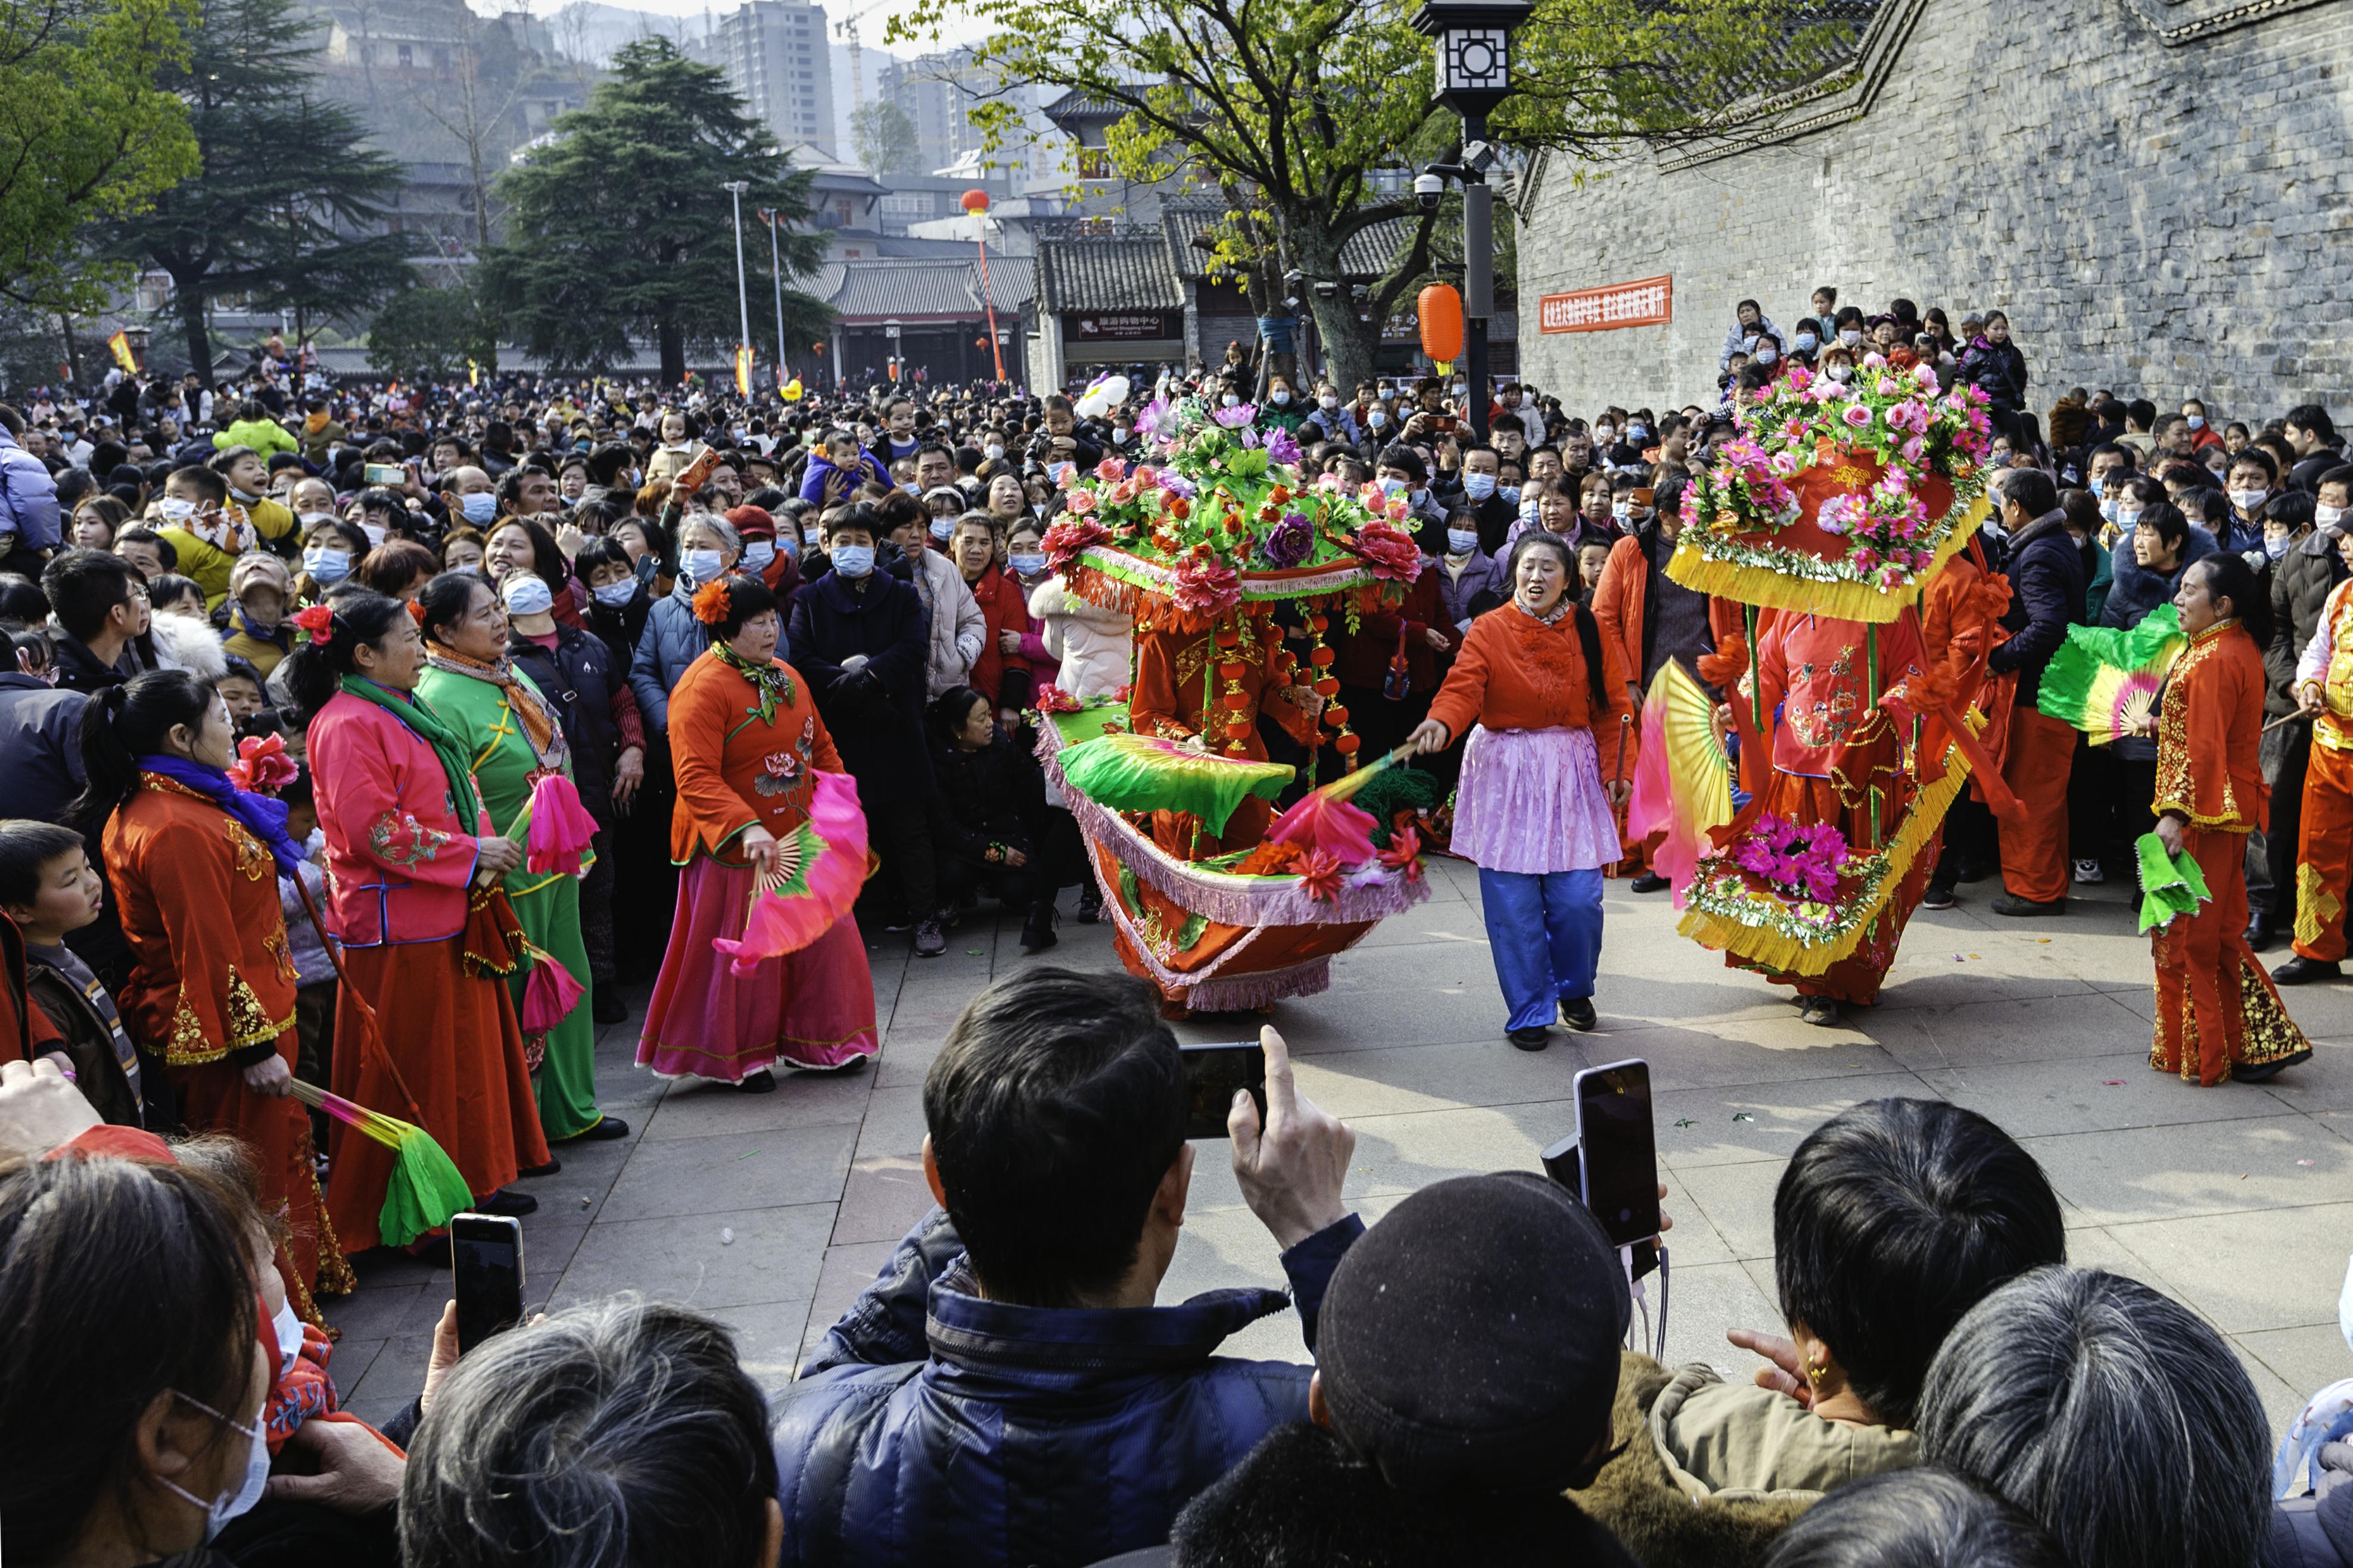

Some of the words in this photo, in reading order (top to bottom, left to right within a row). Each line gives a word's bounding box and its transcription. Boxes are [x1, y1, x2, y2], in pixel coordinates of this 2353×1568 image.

[1099, 316, 1159, 325] 旅游购物中心
